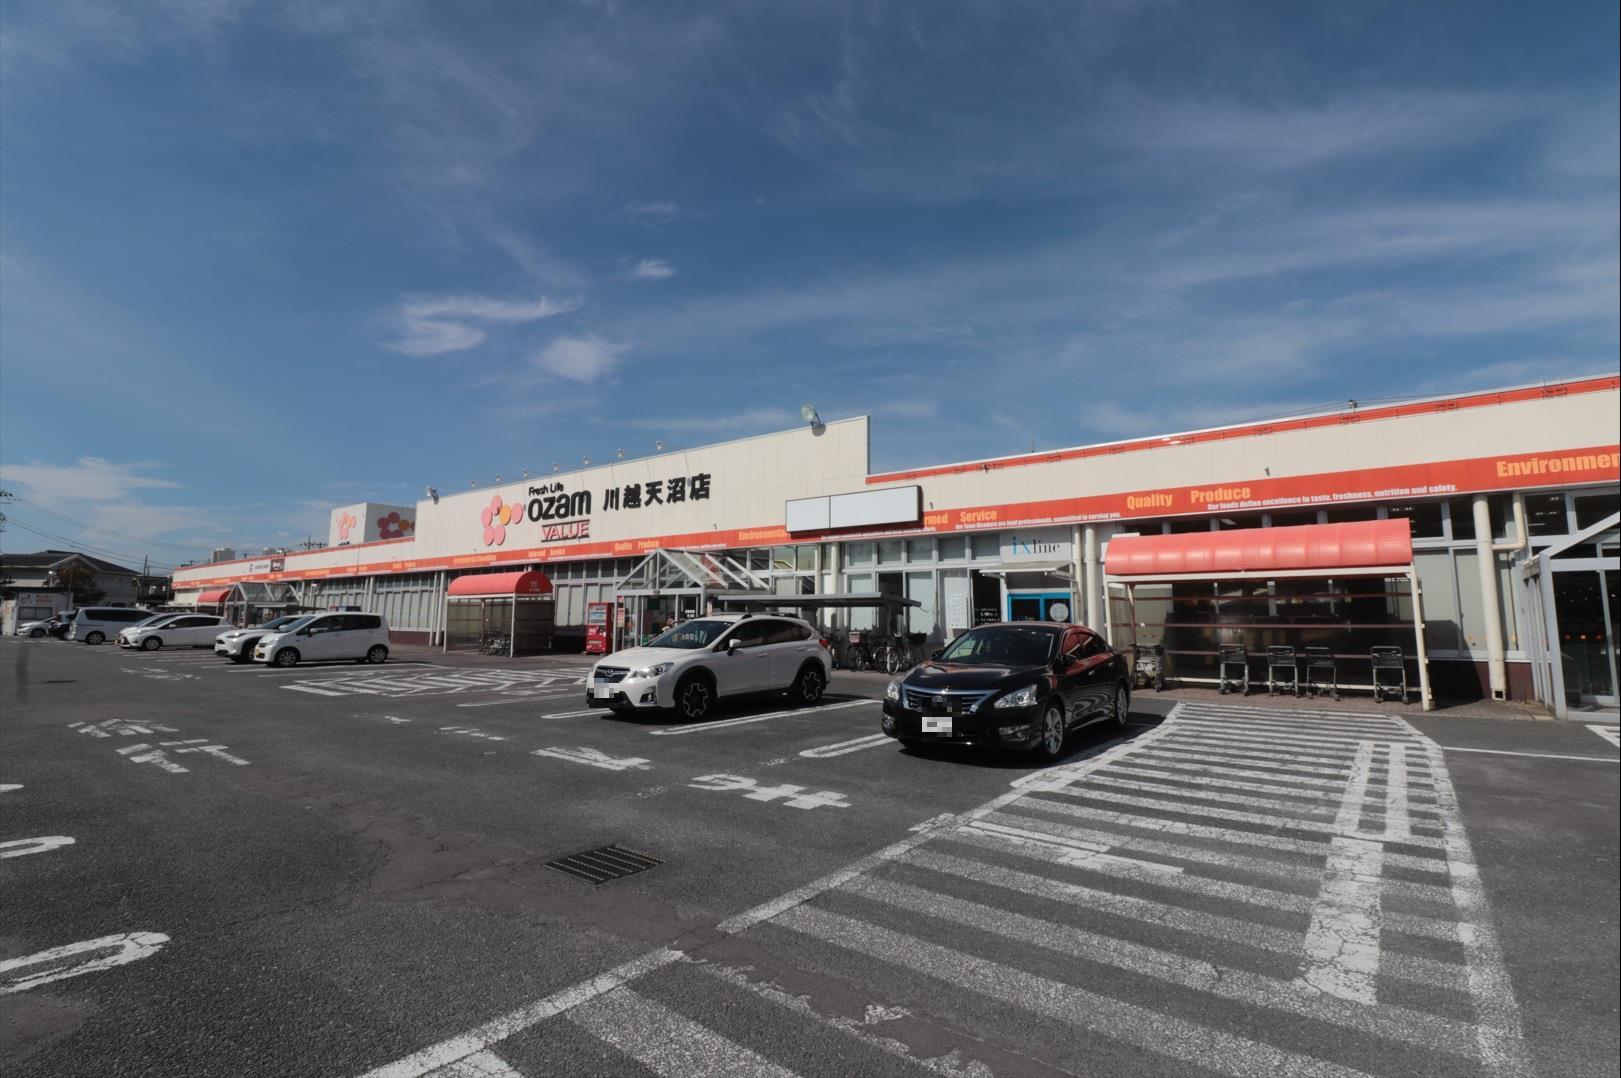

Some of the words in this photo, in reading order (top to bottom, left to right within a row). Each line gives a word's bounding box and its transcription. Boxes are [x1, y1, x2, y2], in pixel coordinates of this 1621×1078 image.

[528, 484, 549, 497] Fresh
[549, 481, 564, 493] Life
[602, 473, 711, 512] 川越天沼店
[1411, 486, 1427, 494] and
[1126, 494, 1173, 510] Quality
[1190, 487, 1251, 504] Produce
[960, 510, 997, 523] Service
[542, 521, 589, 541] VALUE
